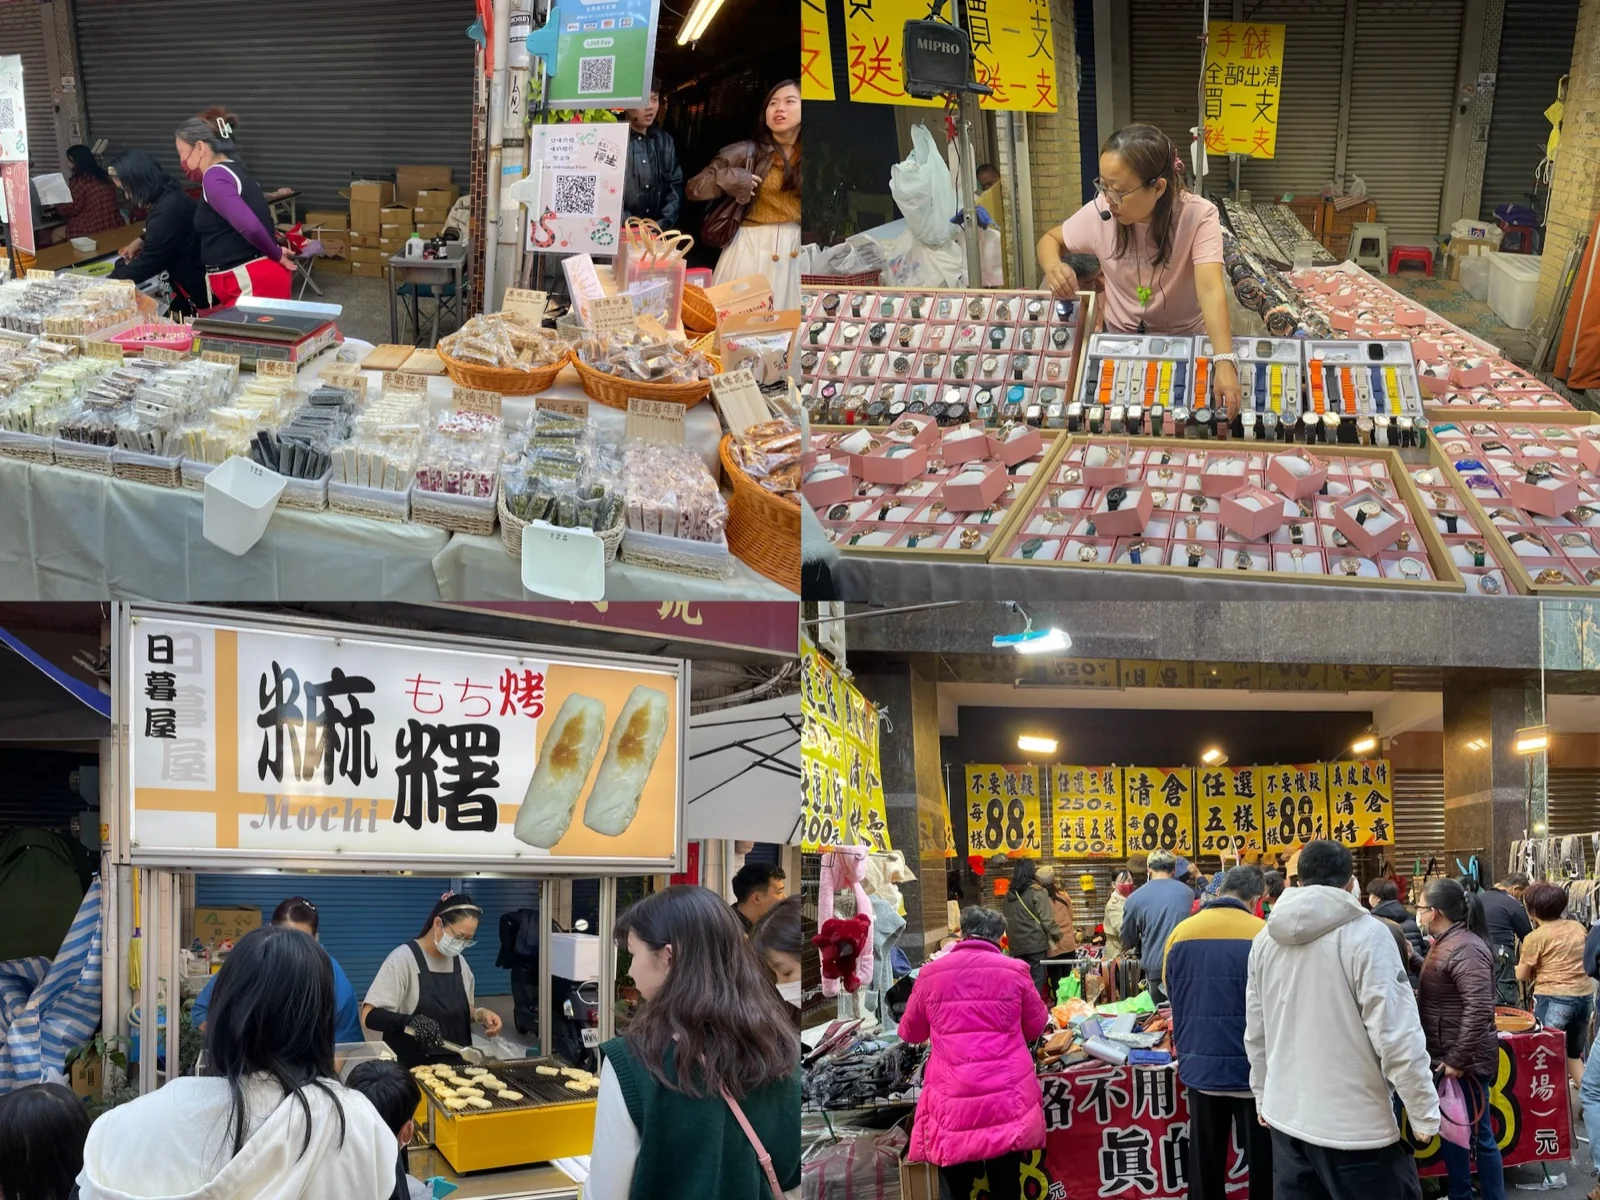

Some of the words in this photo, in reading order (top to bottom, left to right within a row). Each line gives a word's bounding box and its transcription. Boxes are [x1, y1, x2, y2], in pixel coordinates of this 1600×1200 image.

[1216, 24, 1272, 60] 手錶
[1205, 62, 1281, 88] 全部出清
[1205, 88, 1277, 124] 買一支
[1204, 126, 1275, 157] 送一支
[144, 634, 177, 740] 日暮屋
[405, 672, 492, 718] もち
[971, 771, 1035, 797] 不要懷疑
[1057, 770, 1116, 796] 任選三樣
[1201, 770, 1257, 799] 任選
[1266, 771, 1322, 794] 不要懷疑
[1332, 763, 1387, 788] 真皮皮件
[1128, 772, 1189, 808] 清倉
[1335, 789, 1390, 816] 清倉
[249, 794, 379, 834] Mochi
[1057, 797, 1118, 812] 250元
[1203, 803, 1259, 833] 五樣
[1059, 816, 1117, 841] 任選五樣
[1333, 817, 1390, 844] 特賣
[1058, 840, 1119, 854] 400元
[1201, 835, 1262, 851] 400元
